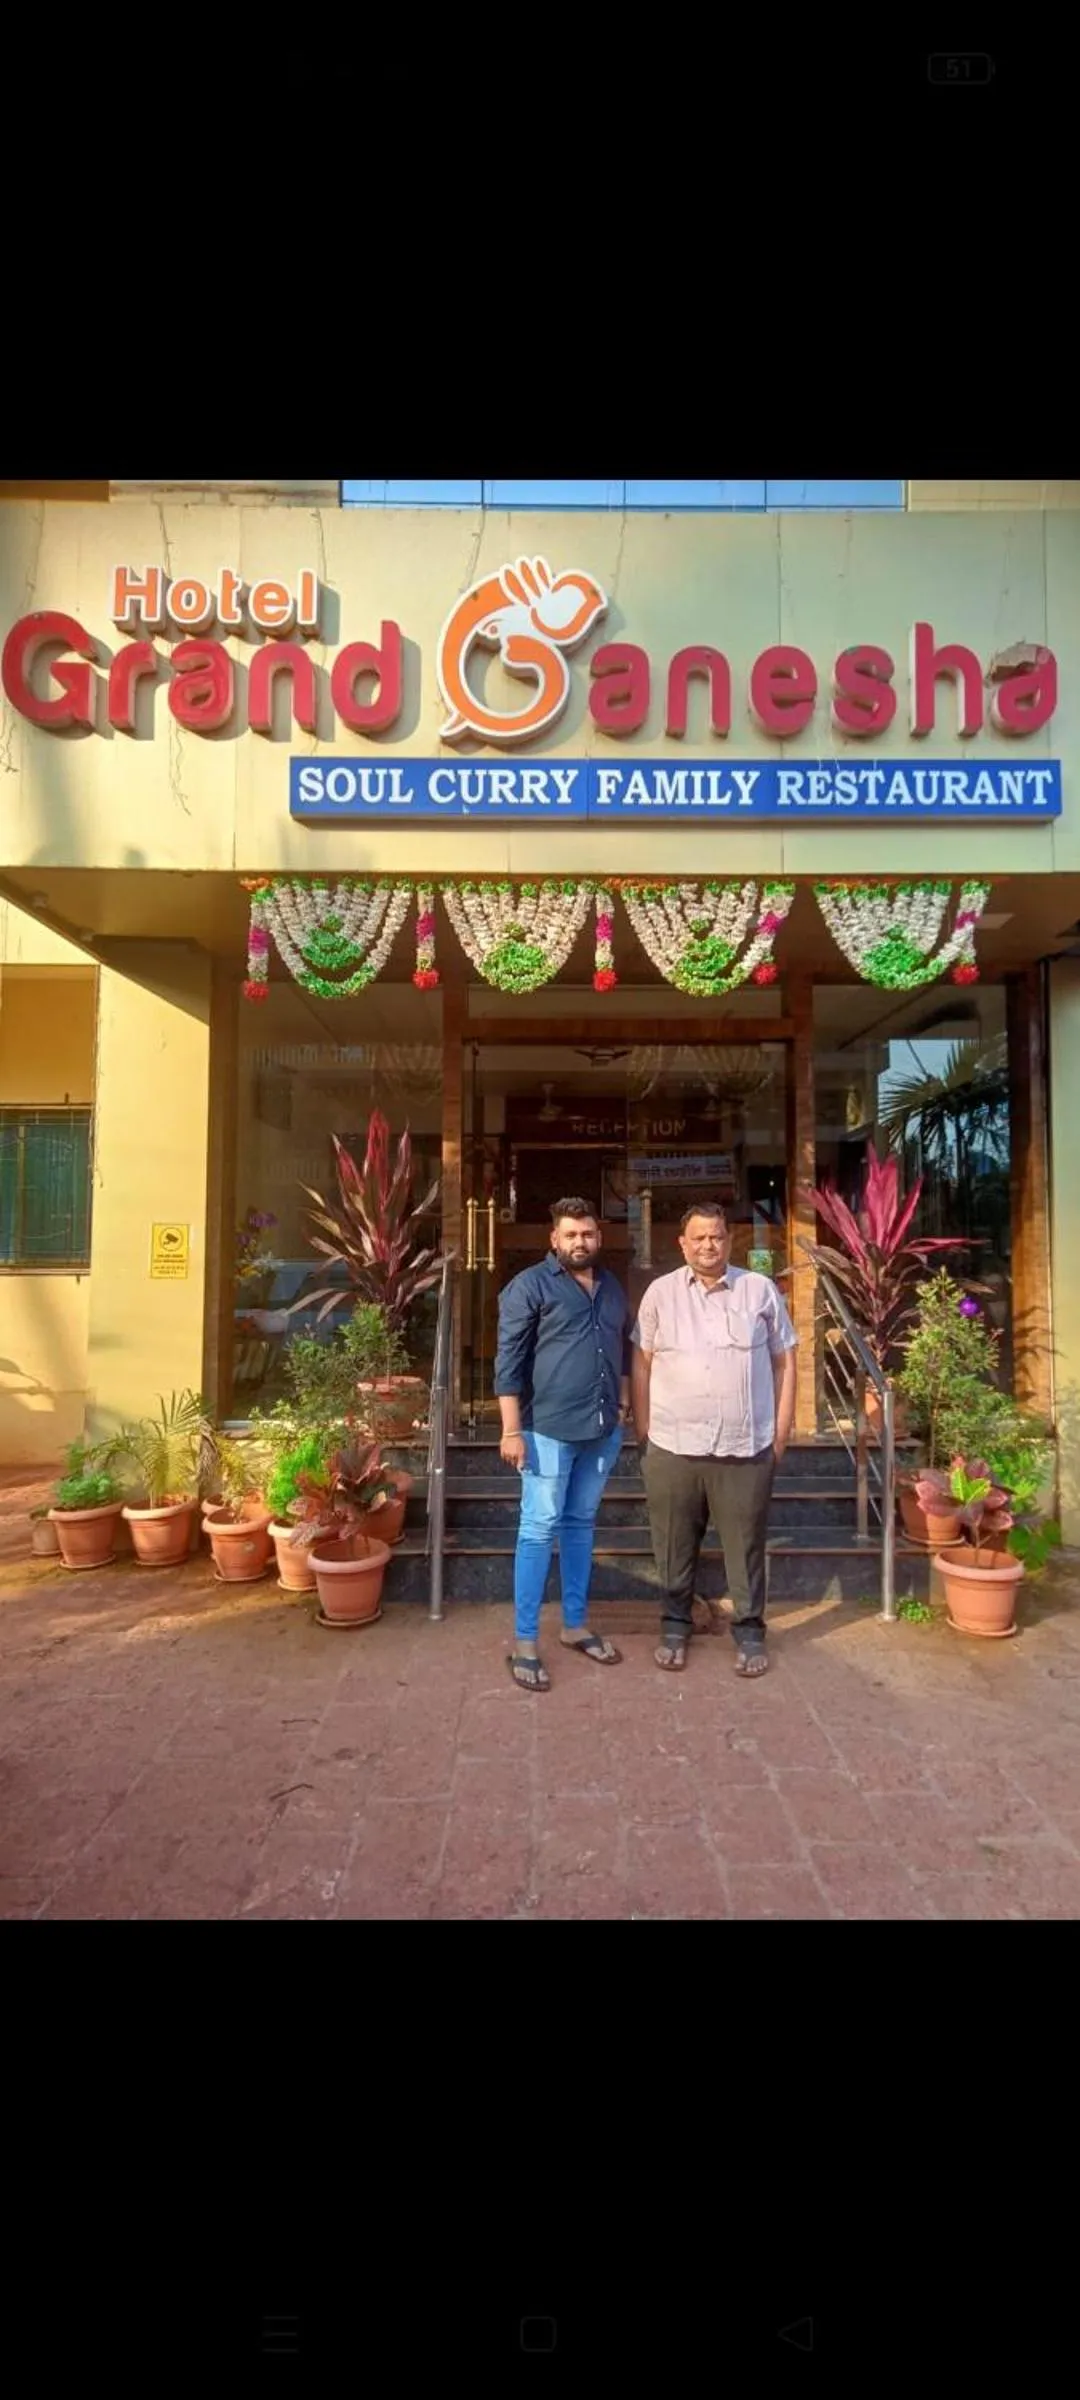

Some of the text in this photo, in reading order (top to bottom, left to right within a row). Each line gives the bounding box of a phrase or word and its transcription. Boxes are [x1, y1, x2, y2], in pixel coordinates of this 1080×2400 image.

[112, 565, 319, 626] Hotel
[1, 610, 403, 732] Grand
[298, 767, 1053, 806] SOUL CURRY FAMILY RESTAURANT
